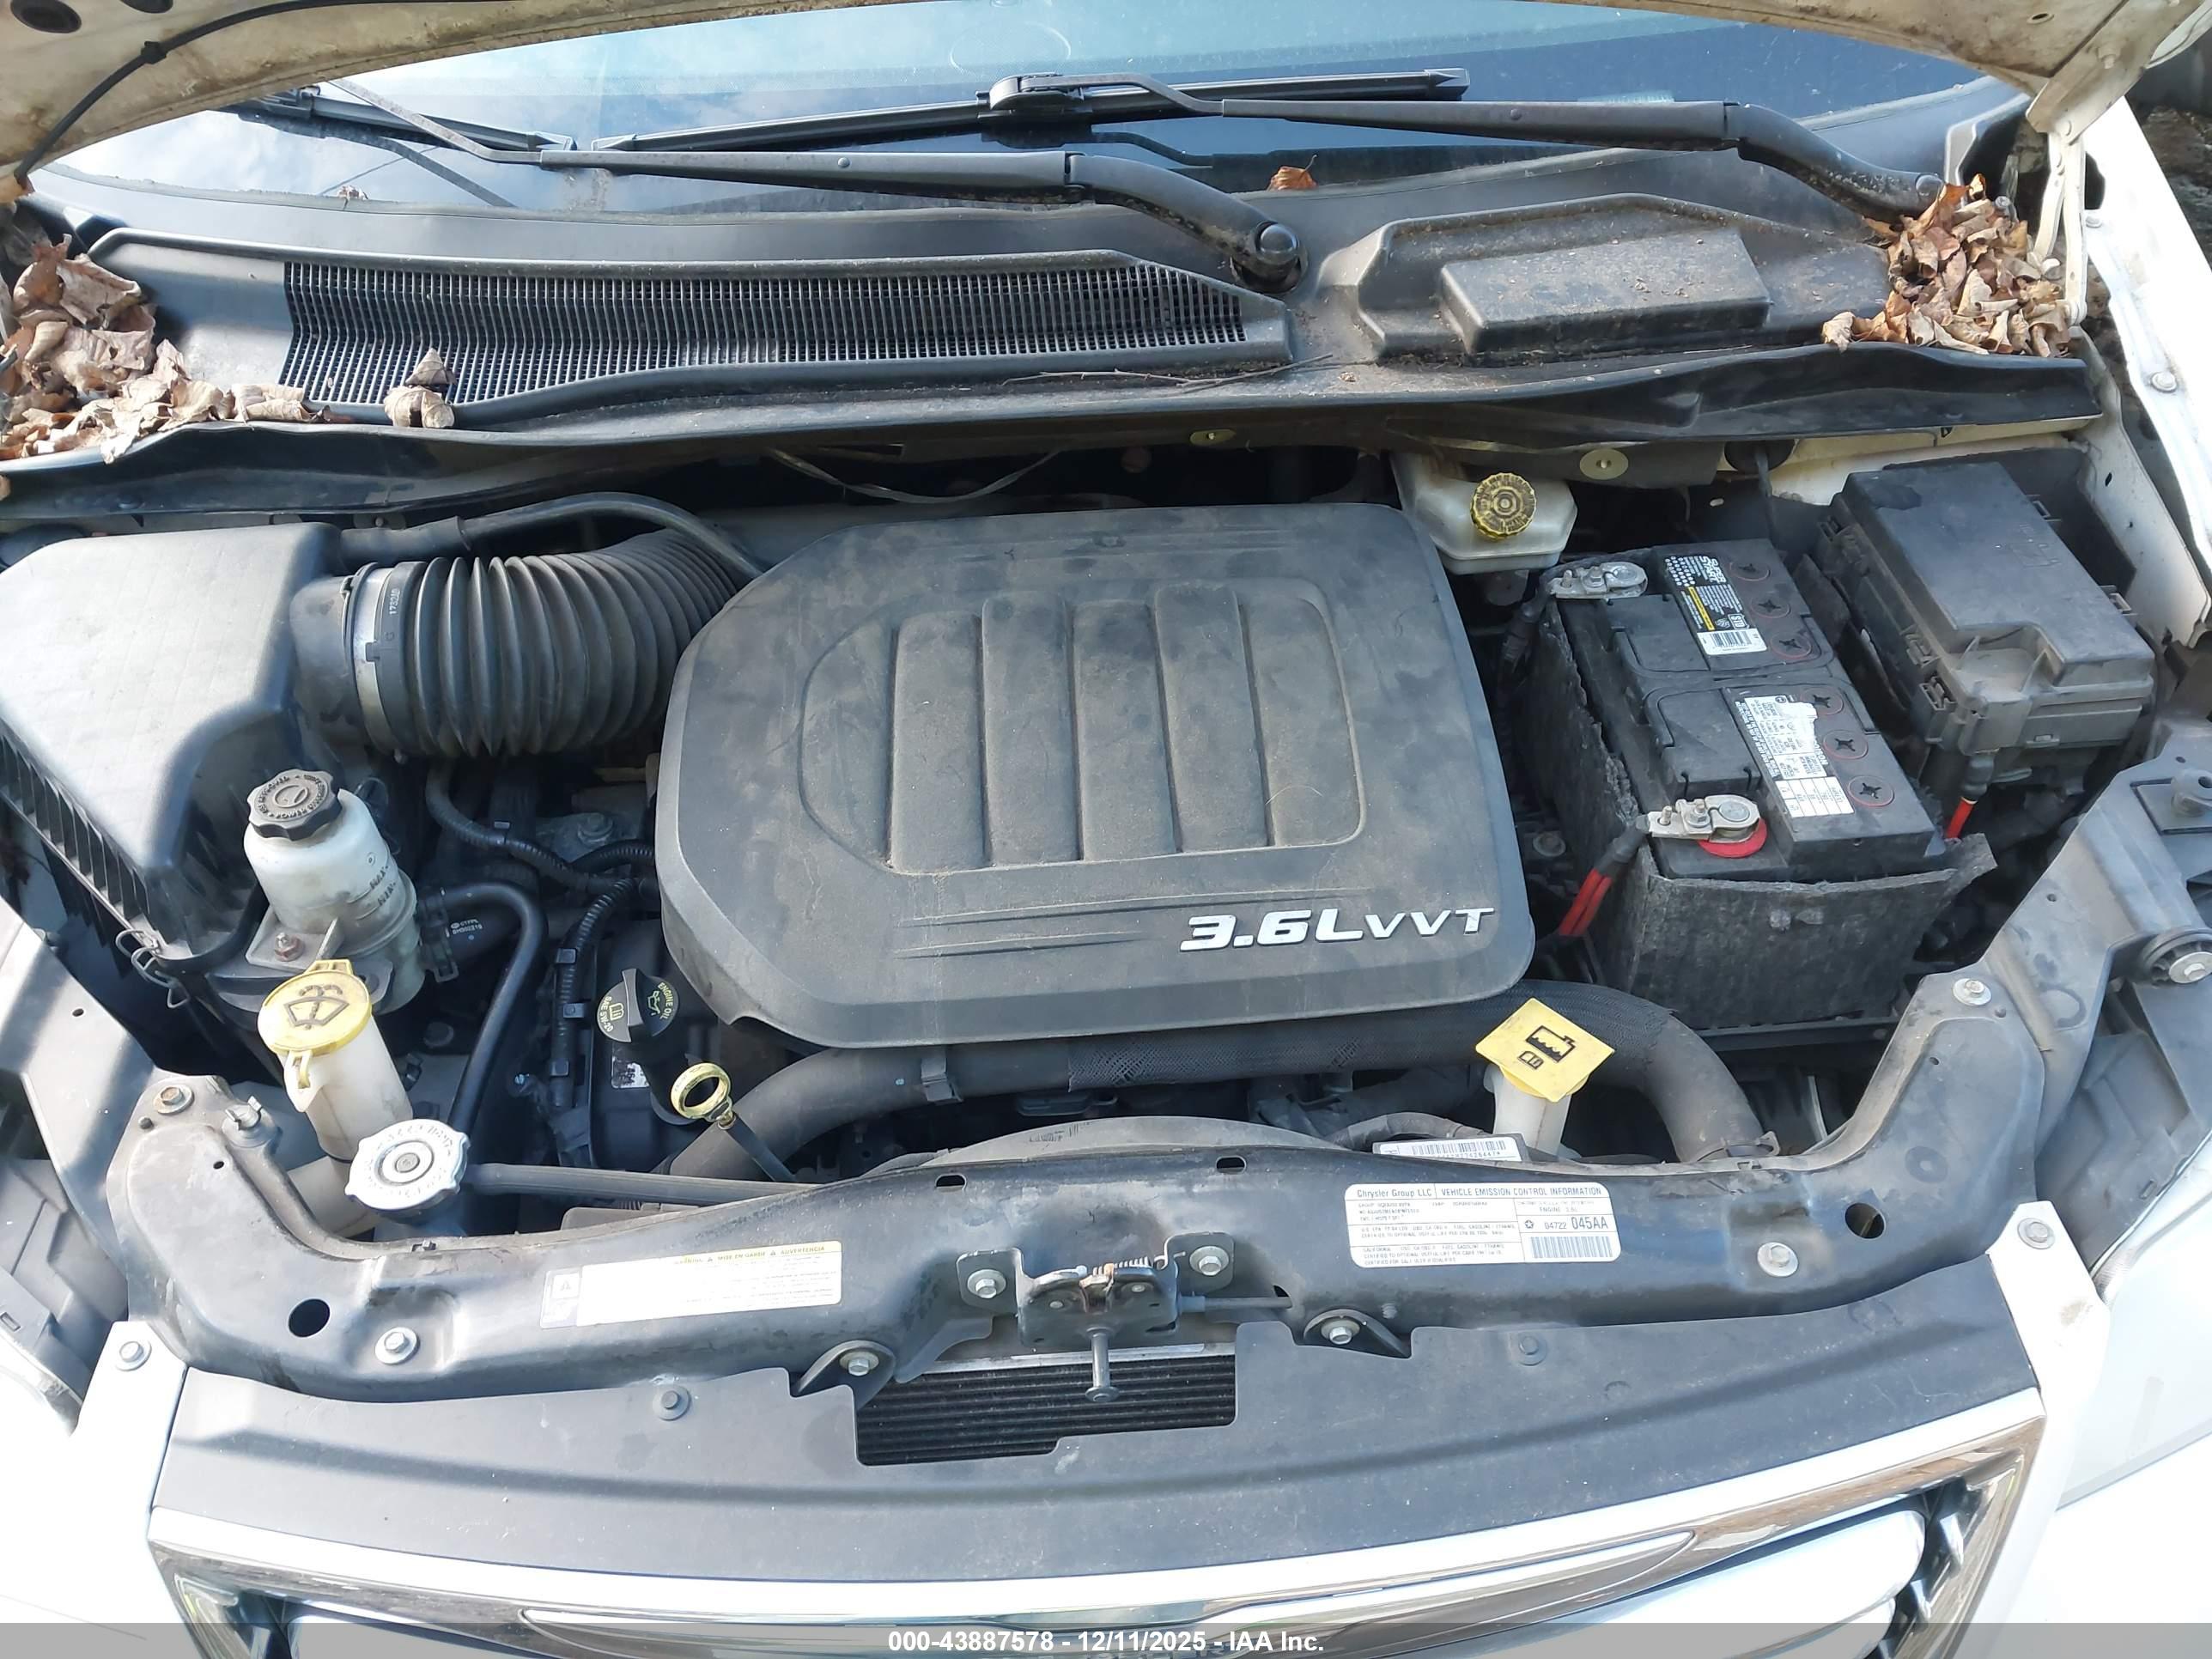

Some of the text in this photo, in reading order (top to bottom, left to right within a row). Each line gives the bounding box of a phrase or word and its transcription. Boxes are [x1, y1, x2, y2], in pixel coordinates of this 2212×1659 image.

[1180, 907, 1495, 952] 3.6L VVT
[658, 981, 673, 1020] ENGINE OIL
[599, 996, 614, 1032] SAE 5W-20
[1357, 1188, 1432, 1199] Chrysler Group LLC
[1441, 1188, 1472, 1196] VEHICLE
[1474, 1188, 1510, 1196] EMISSION
[1550, 1187, 1601, 1195] INFORMATION
[1571, 1216, 1608, 1230] 045AA
